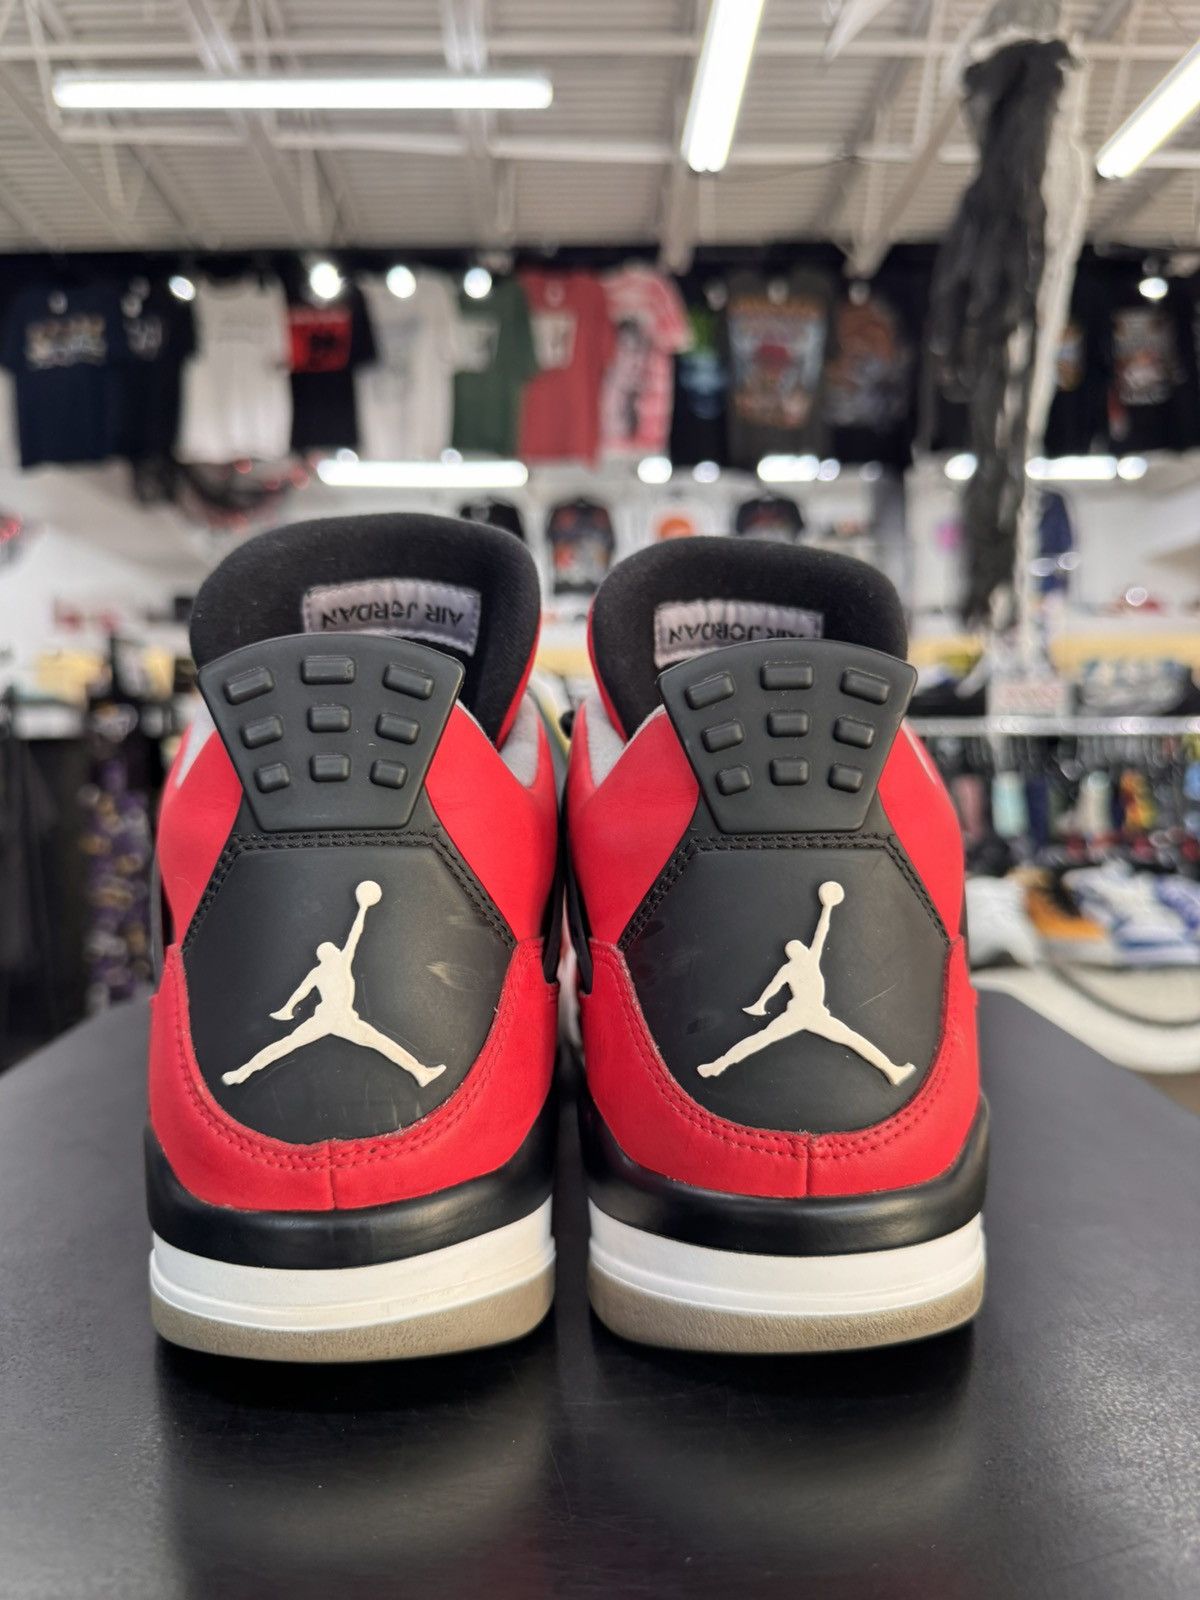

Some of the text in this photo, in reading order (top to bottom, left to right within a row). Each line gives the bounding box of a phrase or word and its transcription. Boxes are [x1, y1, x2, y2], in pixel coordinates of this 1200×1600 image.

[321, 601, 465, 629] AIR JORDAN
[668, 621, 760, 645] JORDAN
